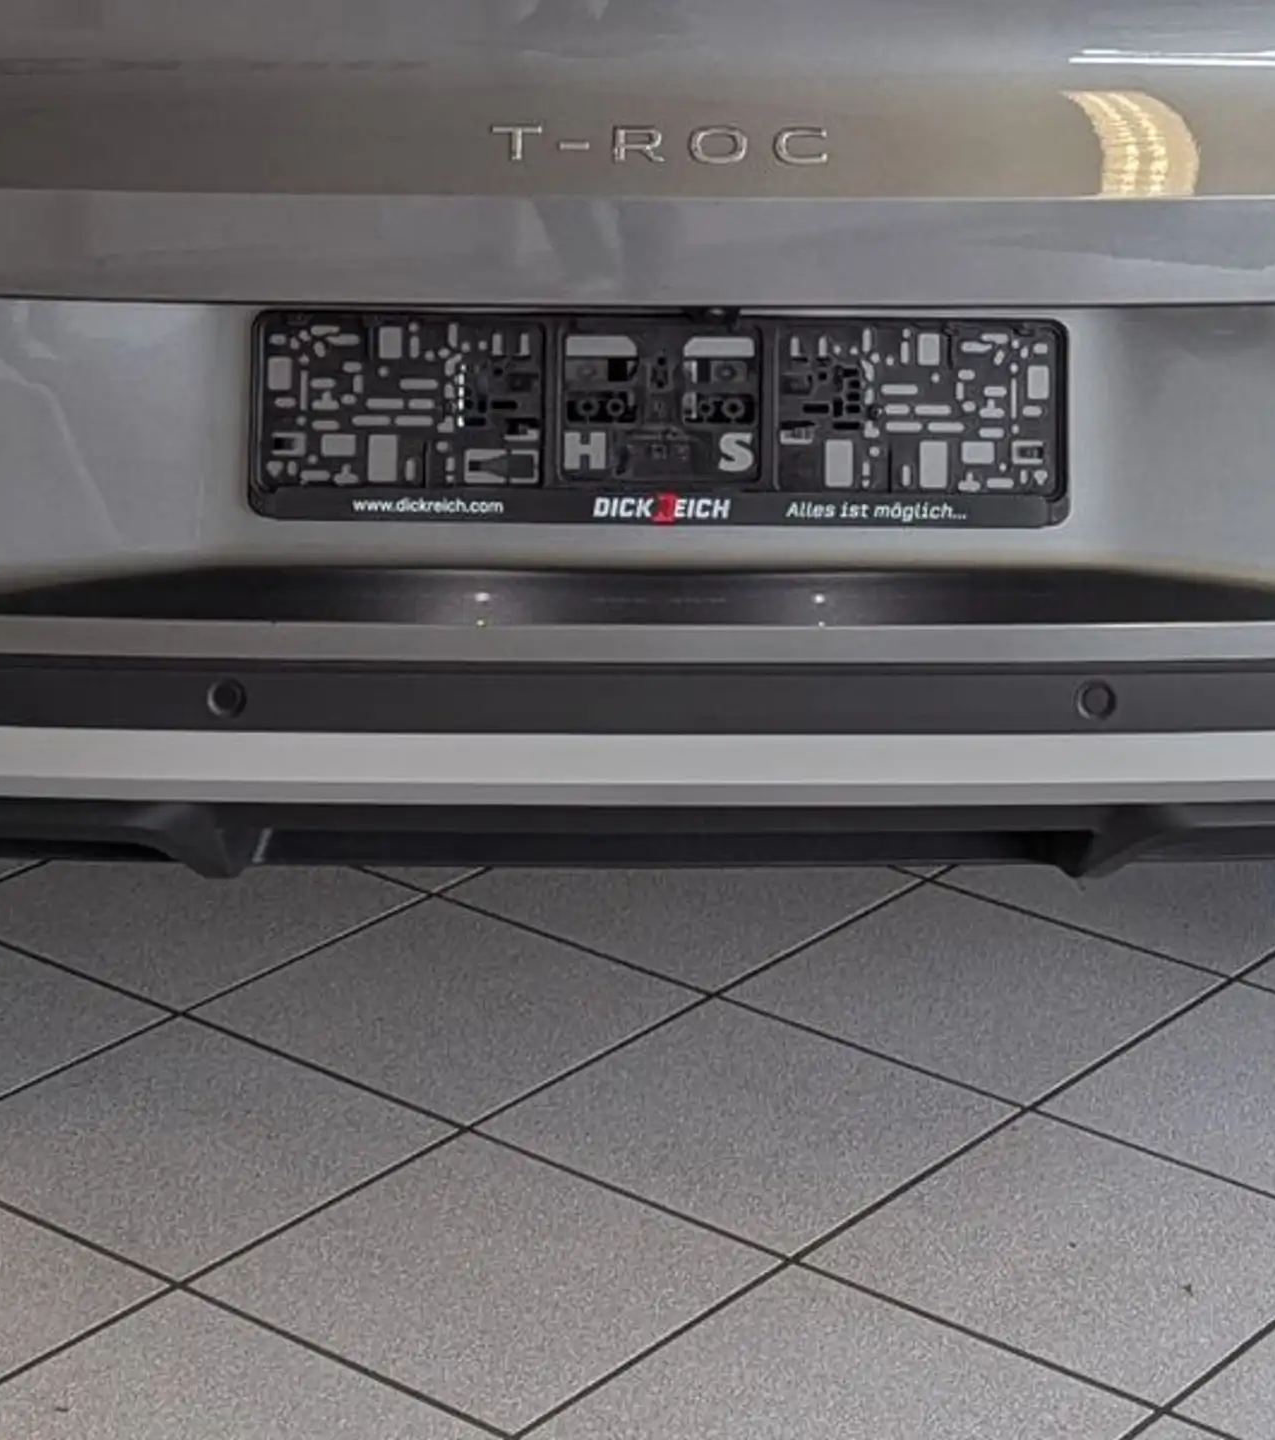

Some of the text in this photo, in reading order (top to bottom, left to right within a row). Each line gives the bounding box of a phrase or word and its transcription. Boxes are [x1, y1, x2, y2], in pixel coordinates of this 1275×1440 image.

[490, 124, 829, 165] T-ROC
[564, 431, 754, 472] H S
[352, 497, 504, 513] www.dickreich.com
[786, 502, 967, 522] Alles ist möglich...
